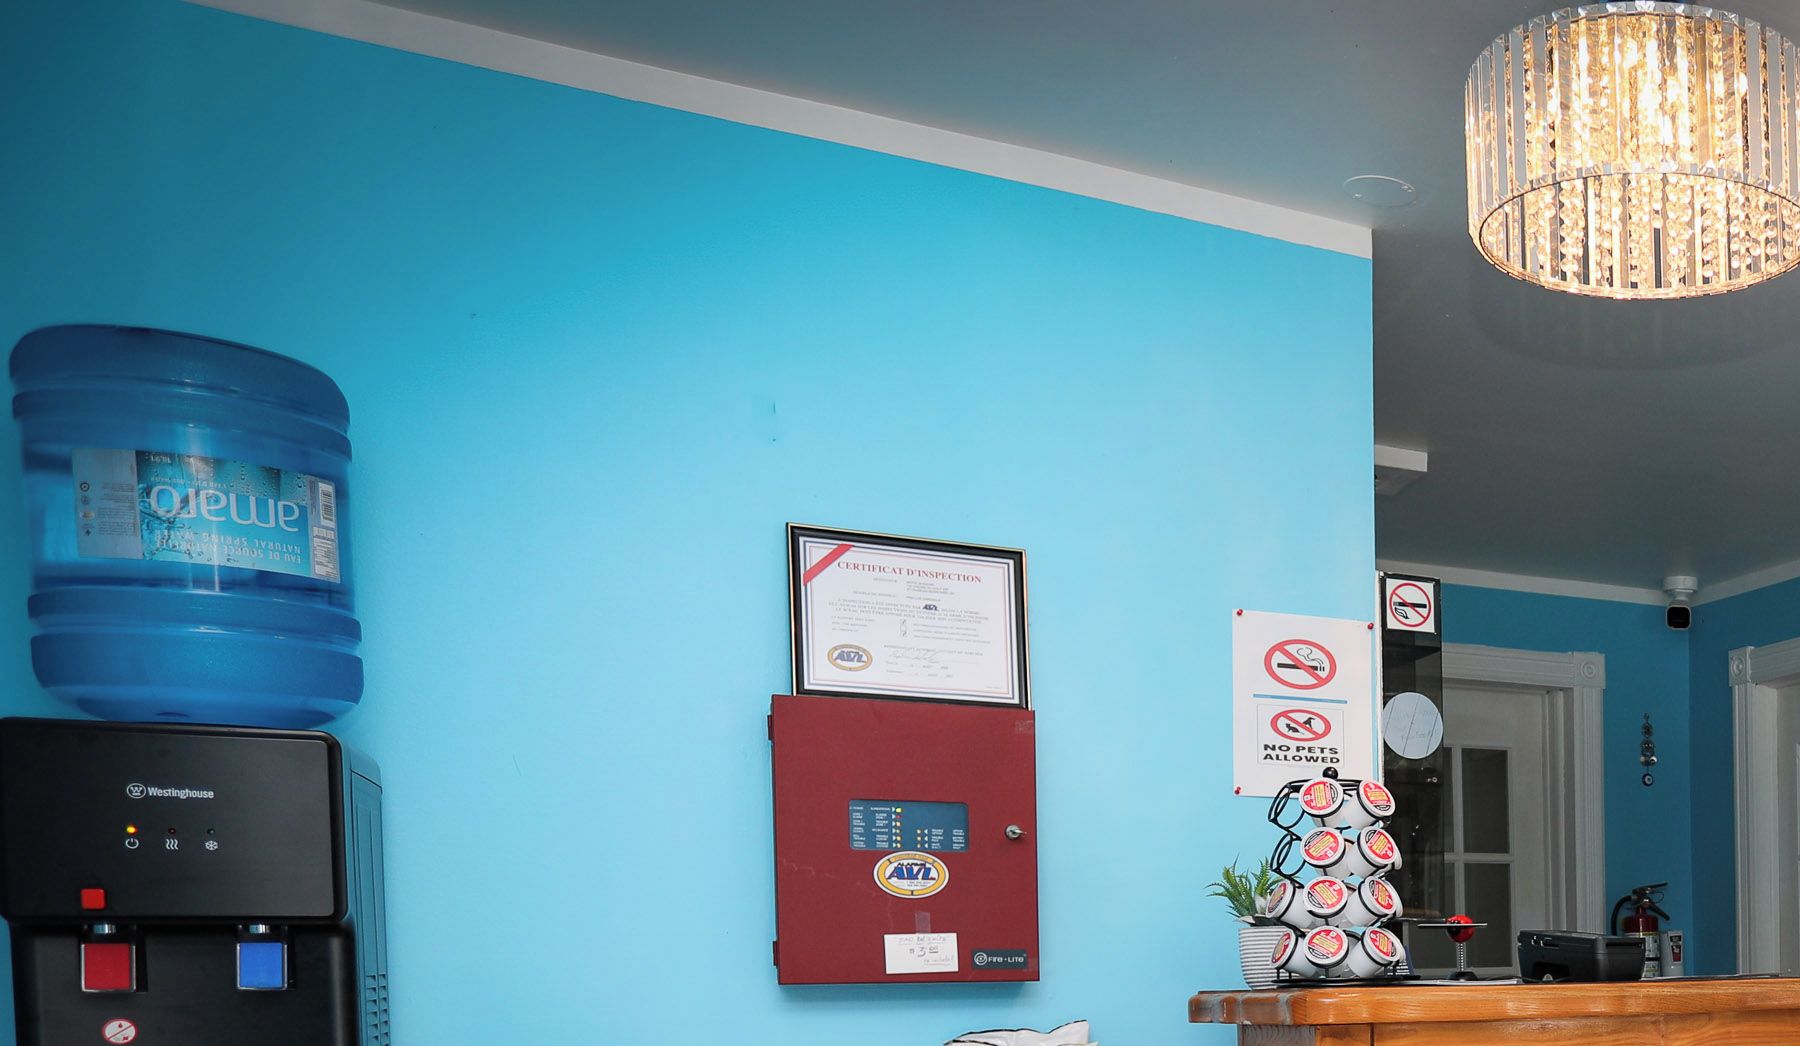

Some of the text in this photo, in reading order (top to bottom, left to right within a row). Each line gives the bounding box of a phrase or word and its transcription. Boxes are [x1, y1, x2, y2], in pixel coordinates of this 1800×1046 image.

[150, 485, 300, 532] amaro
[202, 532, 247, 545] SPRING
[255, 539, 301, 554] NATURAL
[268, 552, 281, 561] DE
[284, 555, 301, 564] EAU
[837, 561, 904, 576] CERTIFICAT
[906, 567, 983, 584] D'INSPECTION
[1263, 744, 1339, 754] NO PETS
[1263, 753, 1340, 763] ALLOWED
[147, 786, 215, 800] Westinghouse
